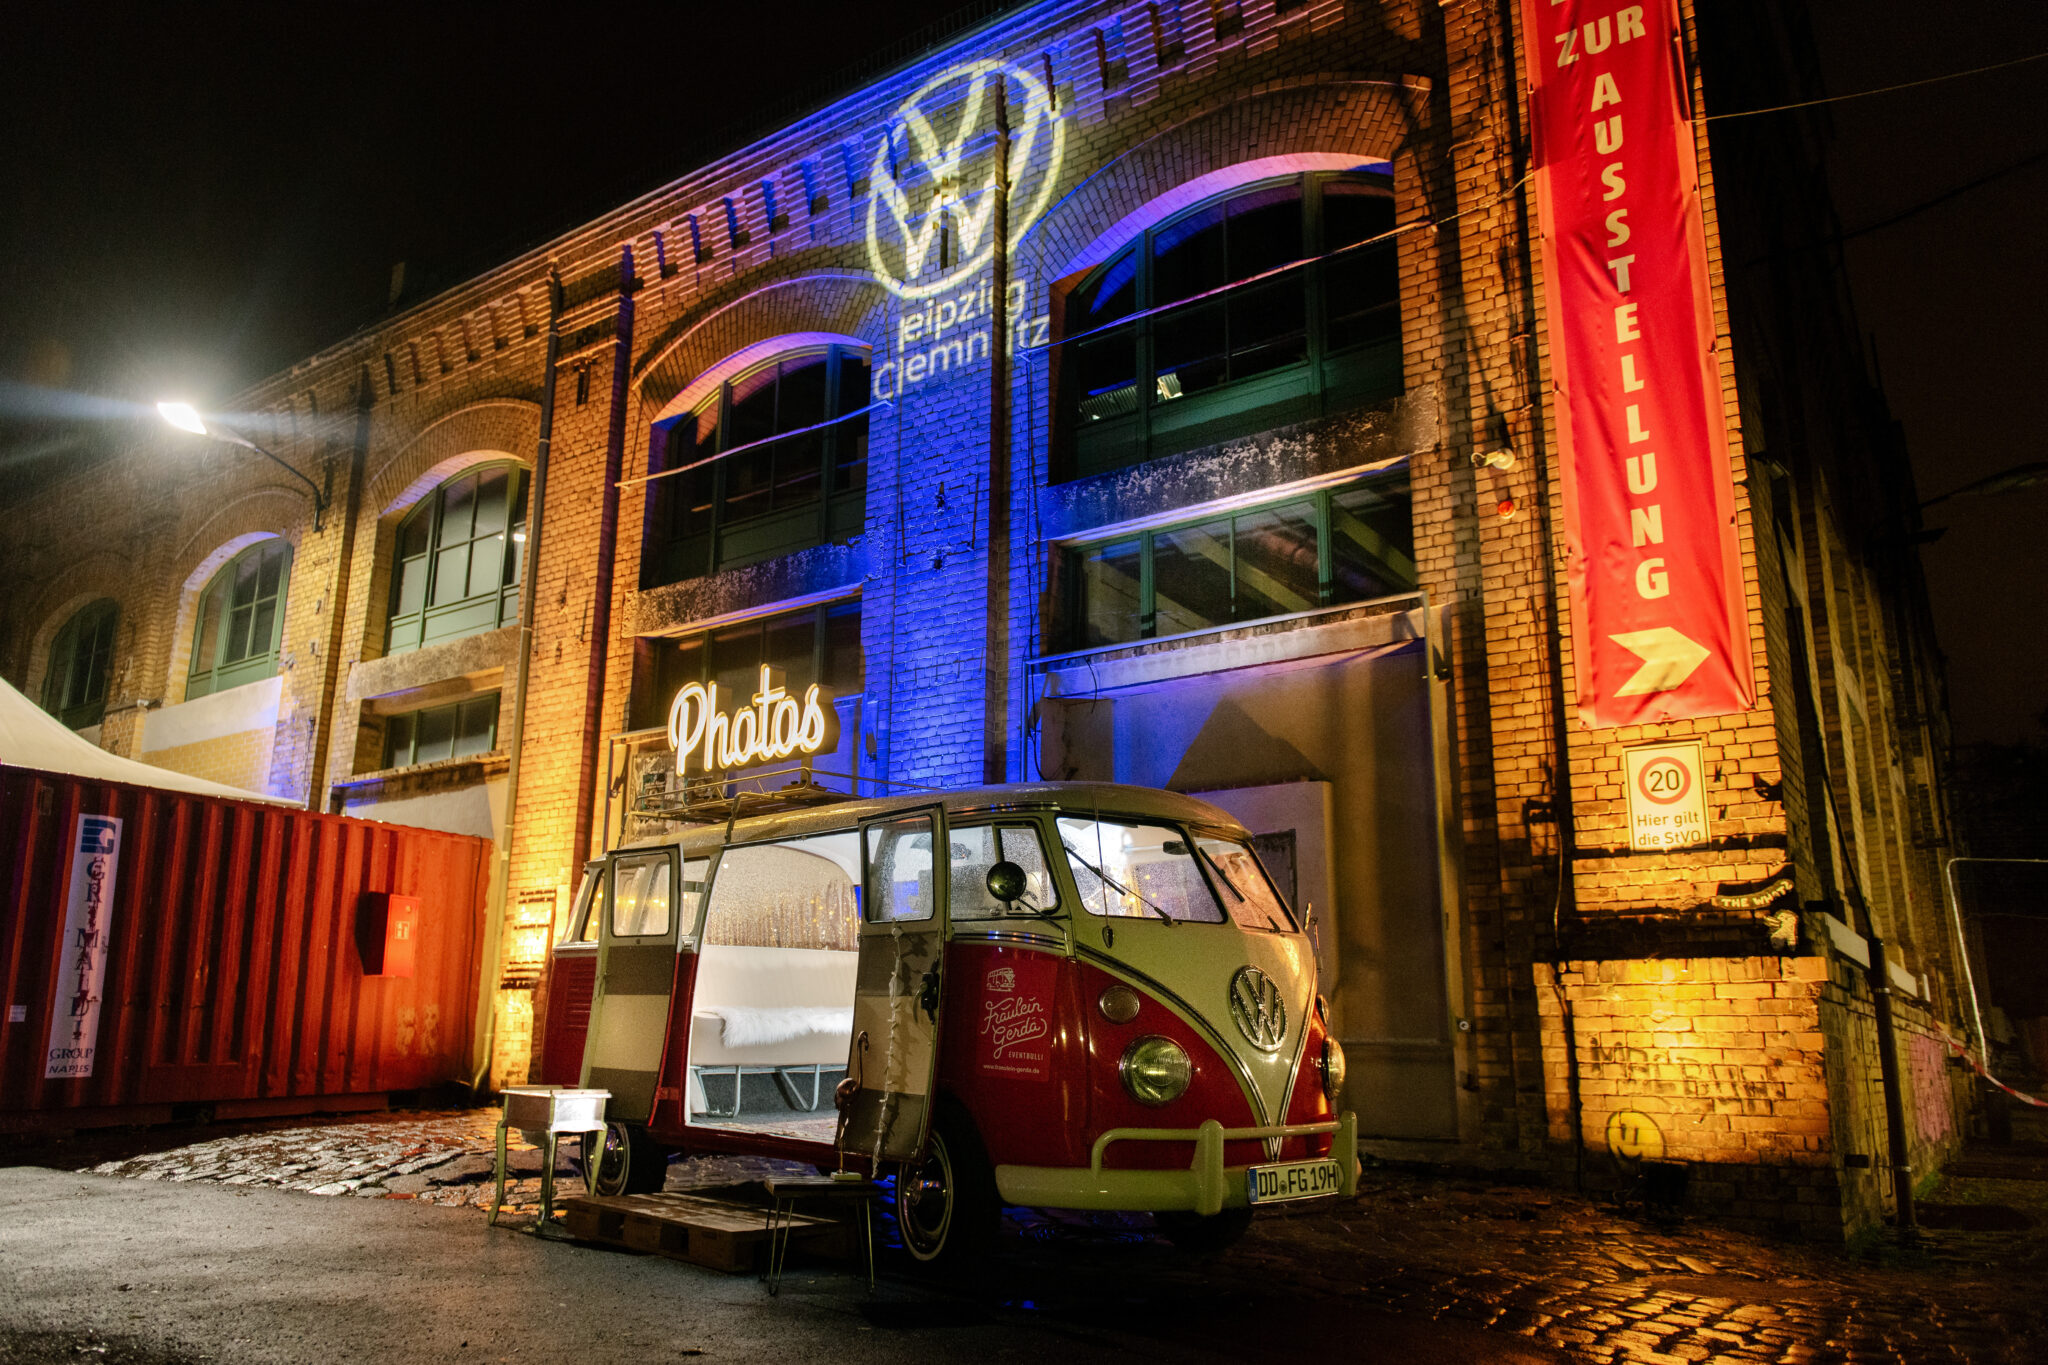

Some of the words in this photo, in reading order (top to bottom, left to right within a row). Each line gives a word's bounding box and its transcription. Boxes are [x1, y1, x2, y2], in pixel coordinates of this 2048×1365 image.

[1555, 5, 1646, 68] ZUR
[1590, 72, 1670, 600] AUSSTELLUNG
[667, 663, 825, 776] Photos
[1649, 769, 1680, 792] 20
[1637, 814, 1669, 827] Hier
[1674, 811, 1699, 828] gilt
[1638, 833, 1660, 846] die
[1664, 829, 1701, 844] StVO
[1720, 897, 1750, 908] THE
[67, 856, 106, 1040] GRMALDI
[981, 997, 1043, 1034] Fräulein
[992, 1017, 1047, 1059] Gerda
[49, 1047, 94, 1062] GROUP
[49, 1065, 90, 1075] NAPLES
[1258, 1171, 1278, 1197] DD
